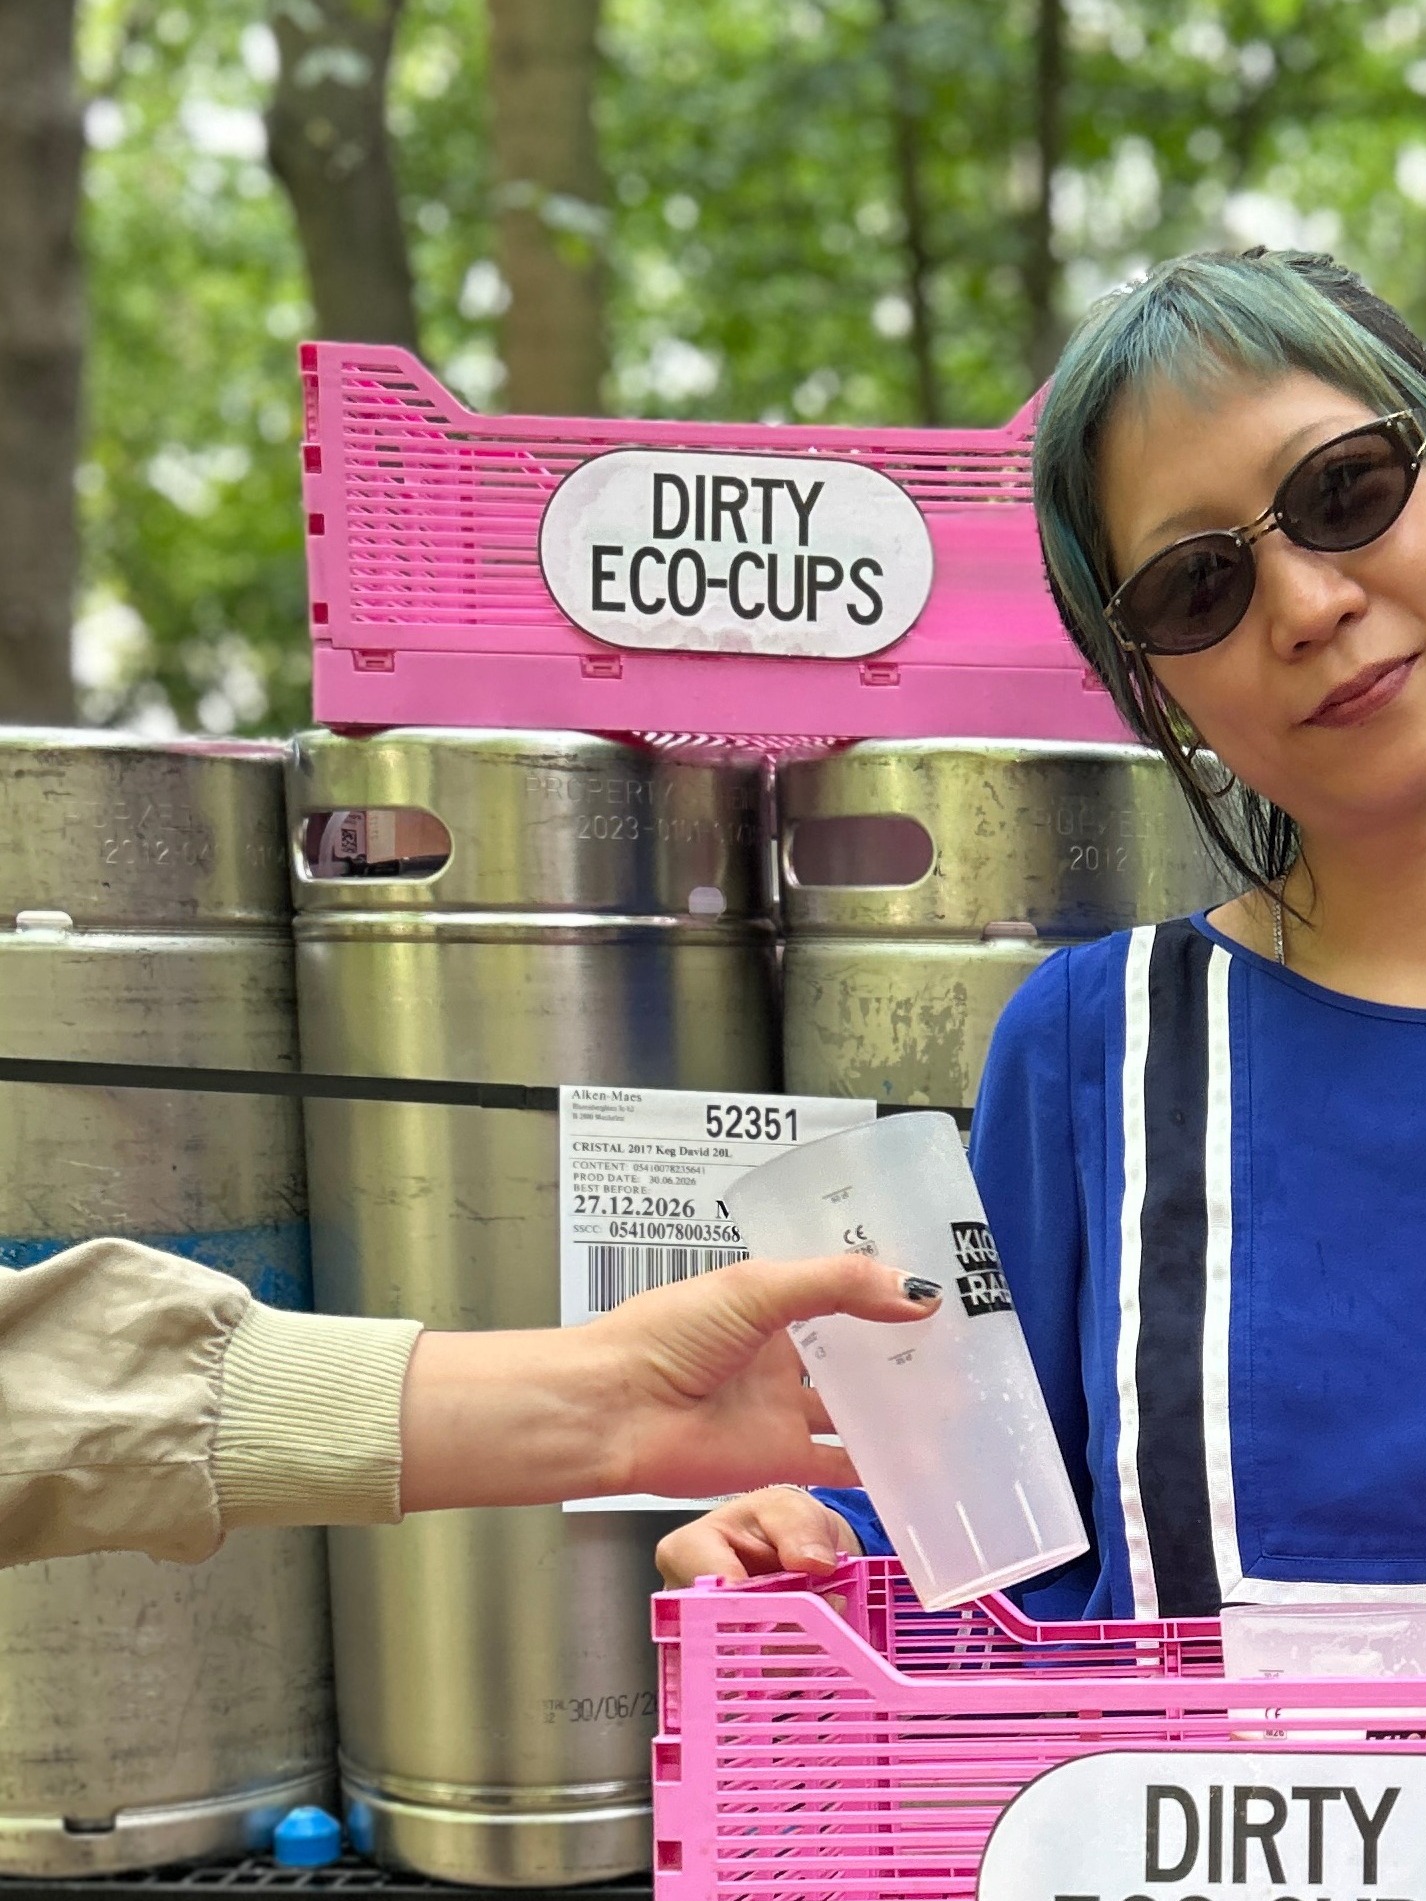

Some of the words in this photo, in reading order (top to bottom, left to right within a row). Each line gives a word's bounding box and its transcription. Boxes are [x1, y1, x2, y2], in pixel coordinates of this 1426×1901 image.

[653, 473, 825, 547] DIRTY
[591, 544, 884, 626] ECO-CUPS
[572, 1089, 643, 1103] Alken-Maes
[706, 1105, 798, 1141] 52351
[572, 1141, 624, 1154] CRISTAL
[628, 1144, 653, 1155] 2017
[656, 1145, 677, 1158] Keg
[679, 1146, 710, 1158] David
[712, 1147, 733, 1158] 20L
[573, 1173, 604, 1183] PROD
[649, 1176, 697, 1186] 30.06.2026
[573, 1184, 600, 1193] BEST
[573, 1194, 696, 1218] 27.12.2026
[1145, 1784, 1401, 1885] DIRTY
